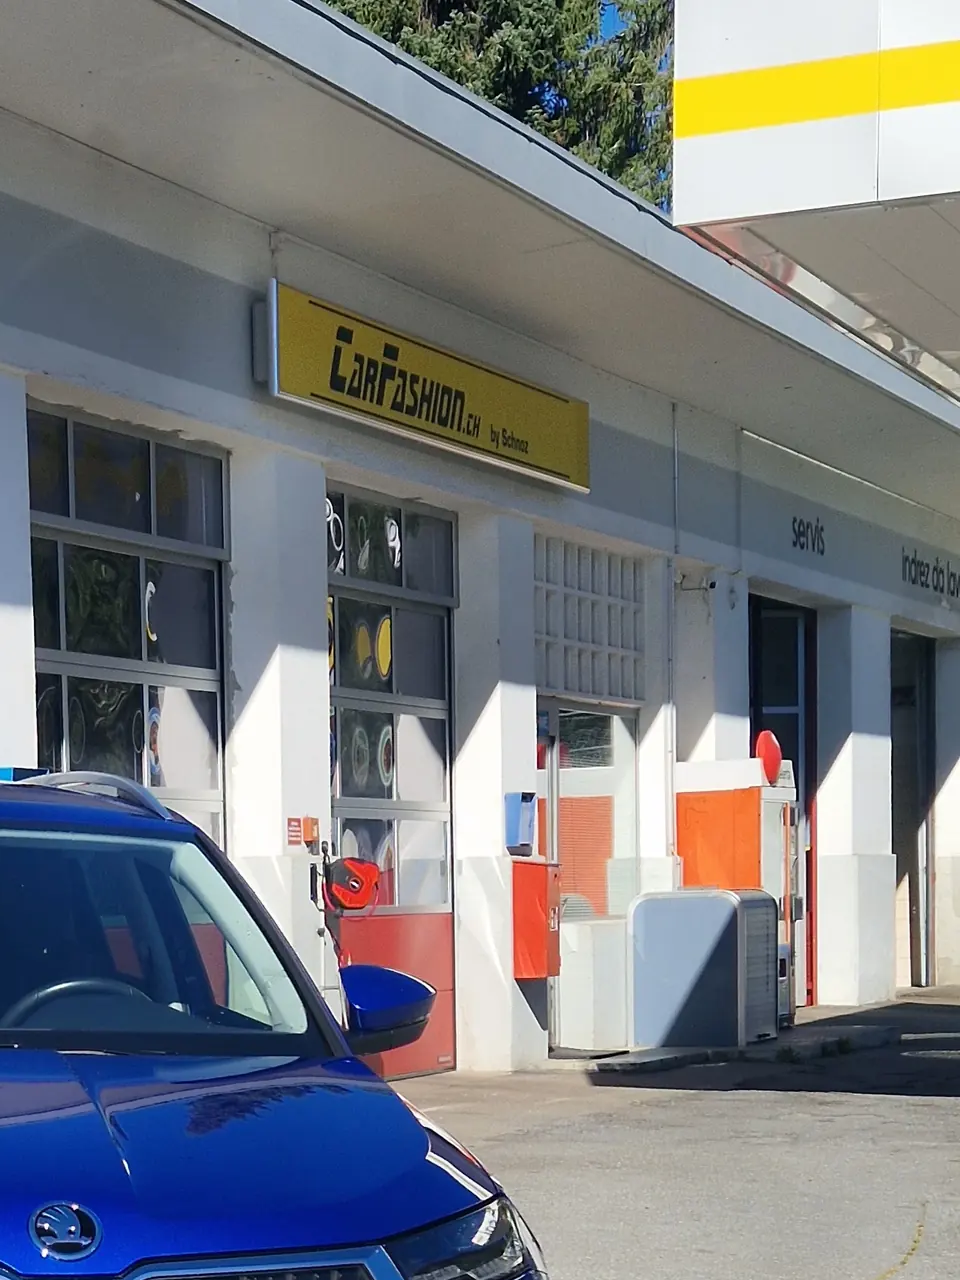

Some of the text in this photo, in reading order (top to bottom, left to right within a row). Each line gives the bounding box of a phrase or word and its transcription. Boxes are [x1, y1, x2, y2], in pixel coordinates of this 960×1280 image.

[490, 423, 500, 450] by
[501, 427, 529, 455] Schnoz
[792, 516, 826, 556] servis
[901, 545, 931, 589] indrez
[931, 556, 945, 594] da
